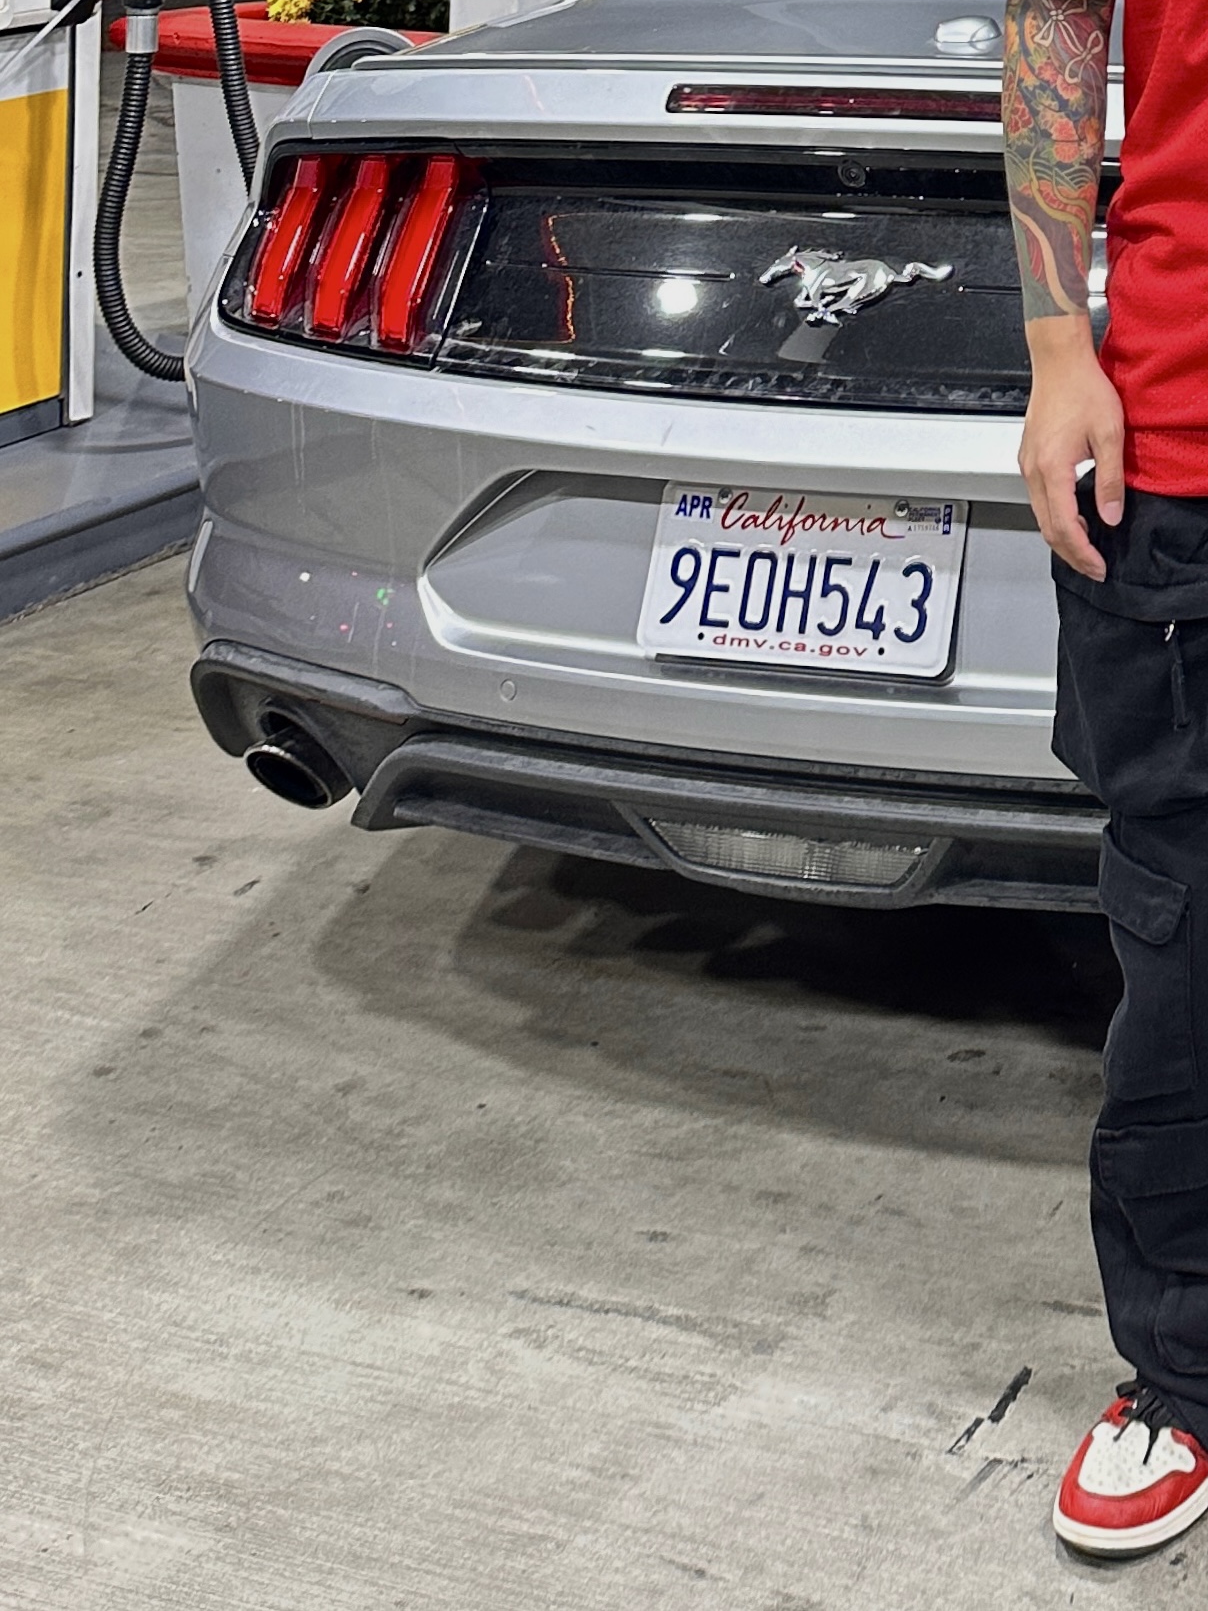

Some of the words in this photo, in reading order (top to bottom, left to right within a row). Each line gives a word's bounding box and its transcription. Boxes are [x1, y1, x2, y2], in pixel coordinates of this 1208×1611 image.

[675, 493, 712, 519] APR
[721, 492, 905, 546] California
[712, 633, 869, 657] dmv.ca.gov
